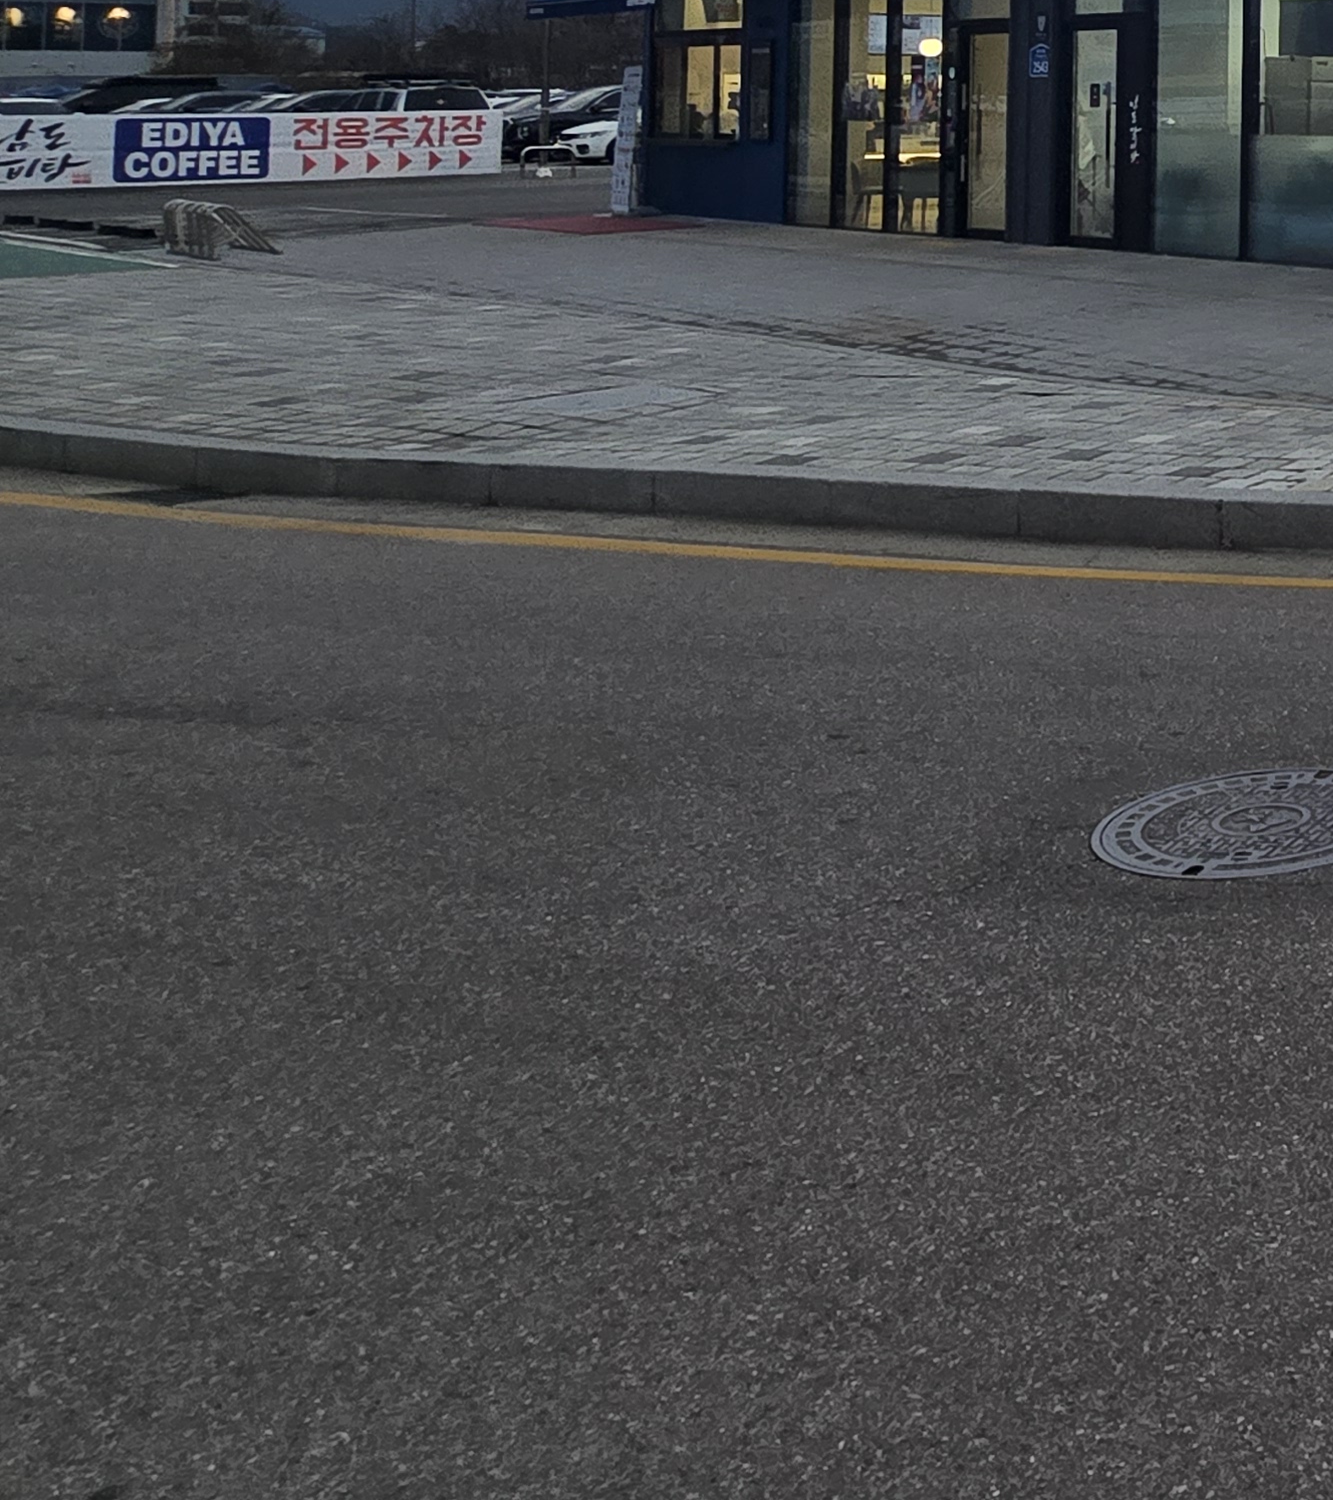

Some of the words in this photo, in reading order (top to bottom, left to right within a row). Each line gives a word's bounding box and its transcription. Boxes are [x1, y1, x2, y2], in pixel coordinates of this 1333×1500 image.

[141, 121, 245, 148] EDIYA
[293, 115, 487, 150] 전용주차장
[124, 149, 260, 179] COFFEE
